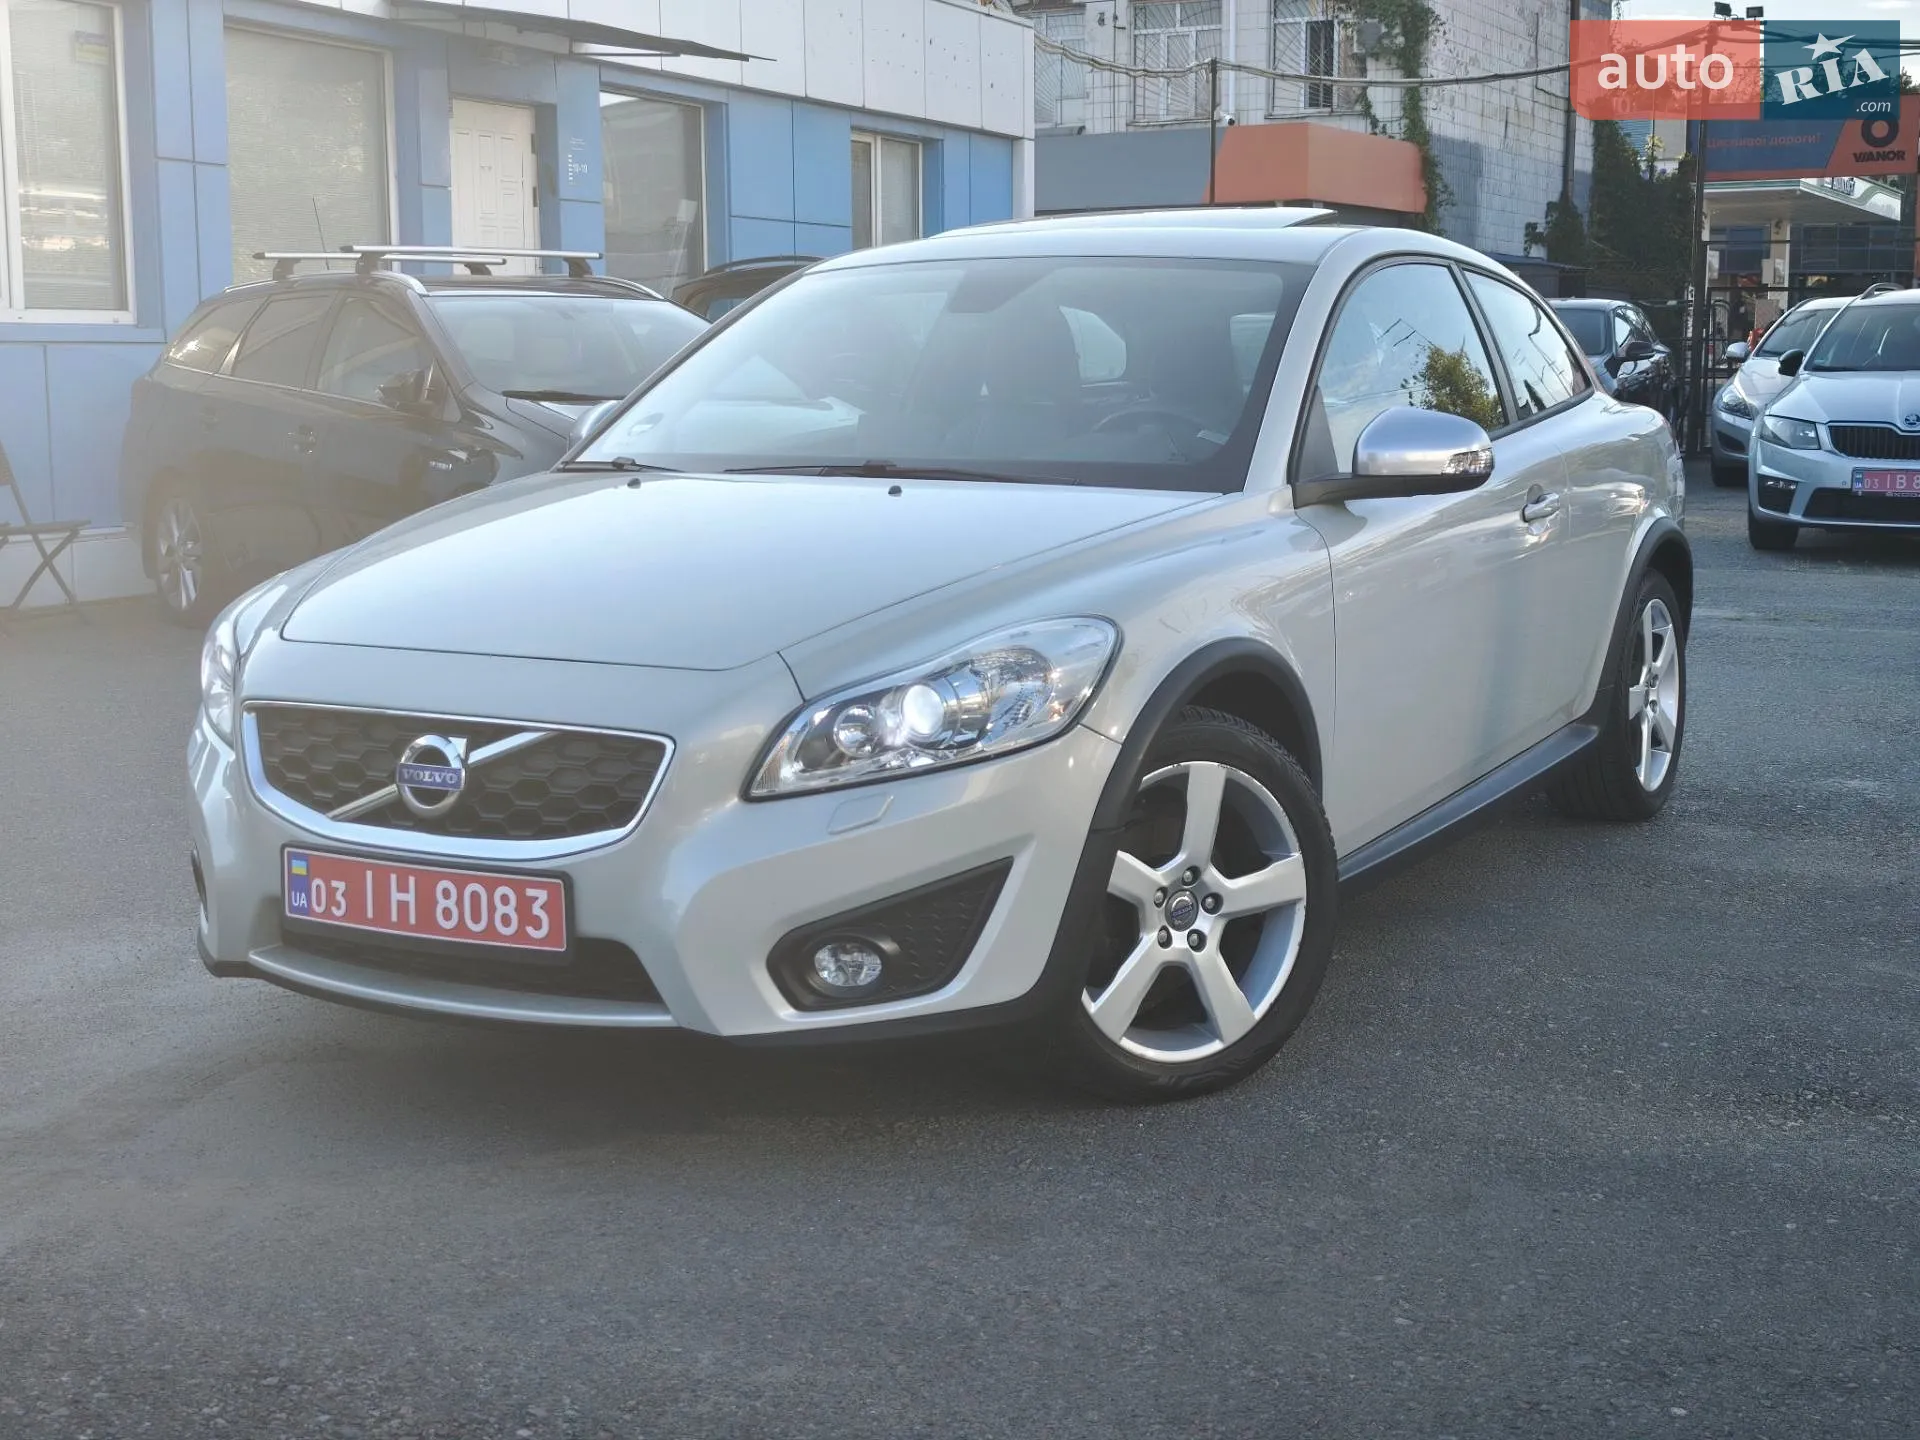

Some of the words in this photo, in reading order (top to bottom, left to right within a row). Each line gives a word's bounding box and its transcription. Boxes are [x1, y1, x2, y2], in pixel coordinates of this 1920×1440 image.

[402, 768, 458, 784] VOLVO
[291, 891, 308, 908] UA
[311, 878, 347, 917] 03
[435, 880, 550, 939] 8083
